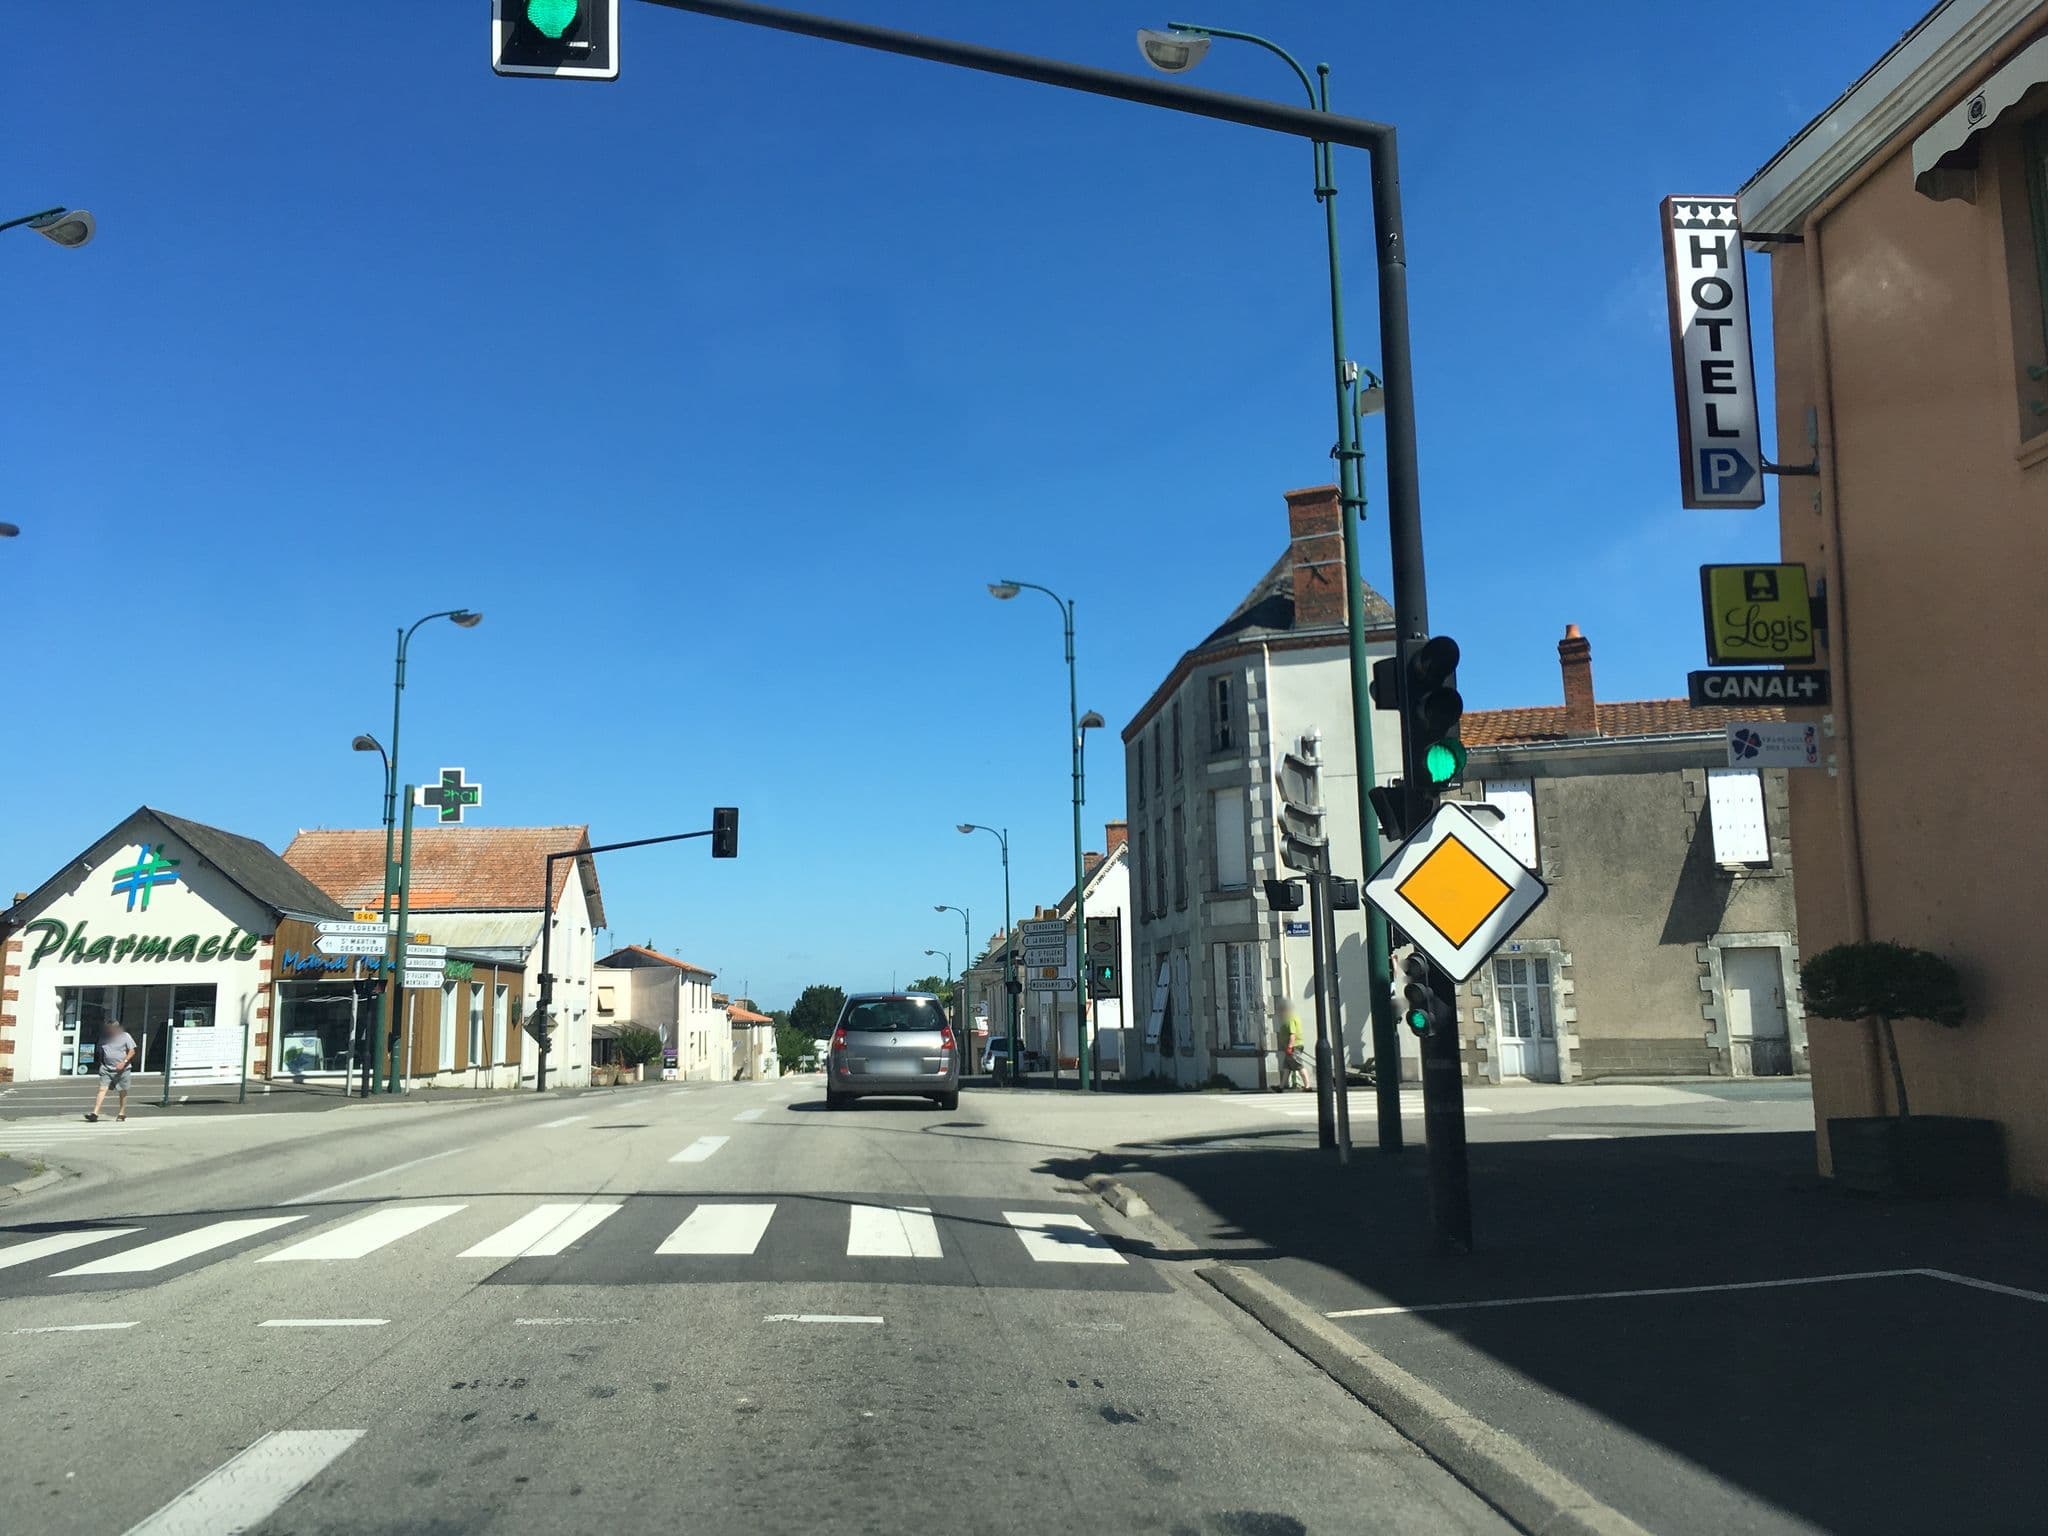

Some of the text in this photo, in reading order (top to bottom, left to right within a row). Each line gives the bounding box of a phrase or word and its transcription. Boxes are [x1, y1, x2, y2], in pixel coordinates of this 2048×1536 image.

[1689, 234, 1740, 438] HOTEL
[1709, 452, 1739, 489] P
[1723, 604, 1809, 653] Logis
[1703, 675, 1820, 699] CANAL+
[23, 917, 260, 969] Pharmacie
[356, 945, 384, 953] NOYERS
